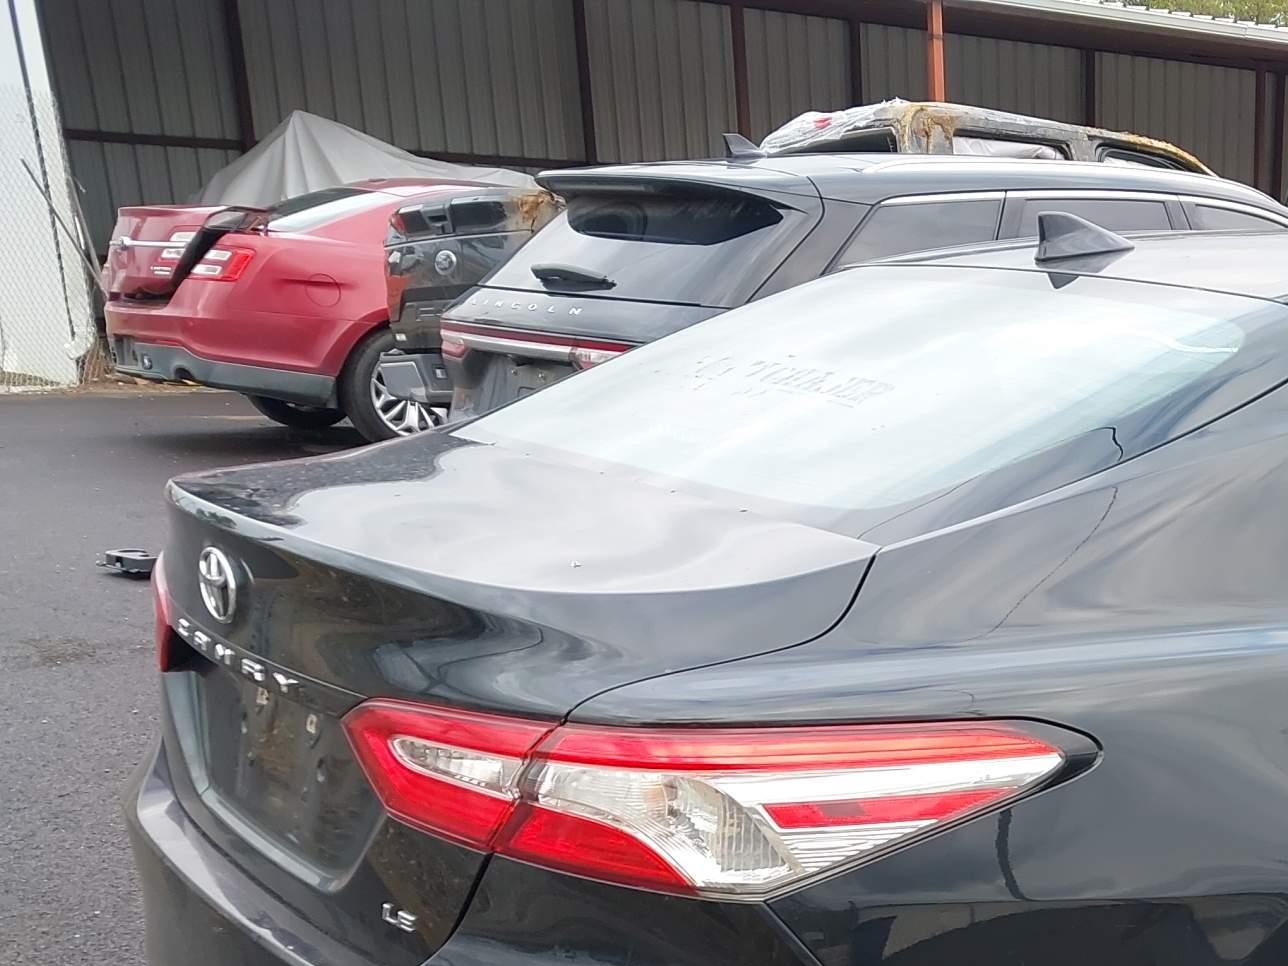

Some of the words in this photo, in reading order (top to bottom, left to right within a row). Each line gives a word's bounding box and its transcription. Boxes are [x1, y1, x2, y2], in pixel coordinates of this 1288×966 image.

[471, 299, 582, 315] LINCOLN
[178, 618, 299, 693] CAMRY
[382, 903, 417, 932] LE
